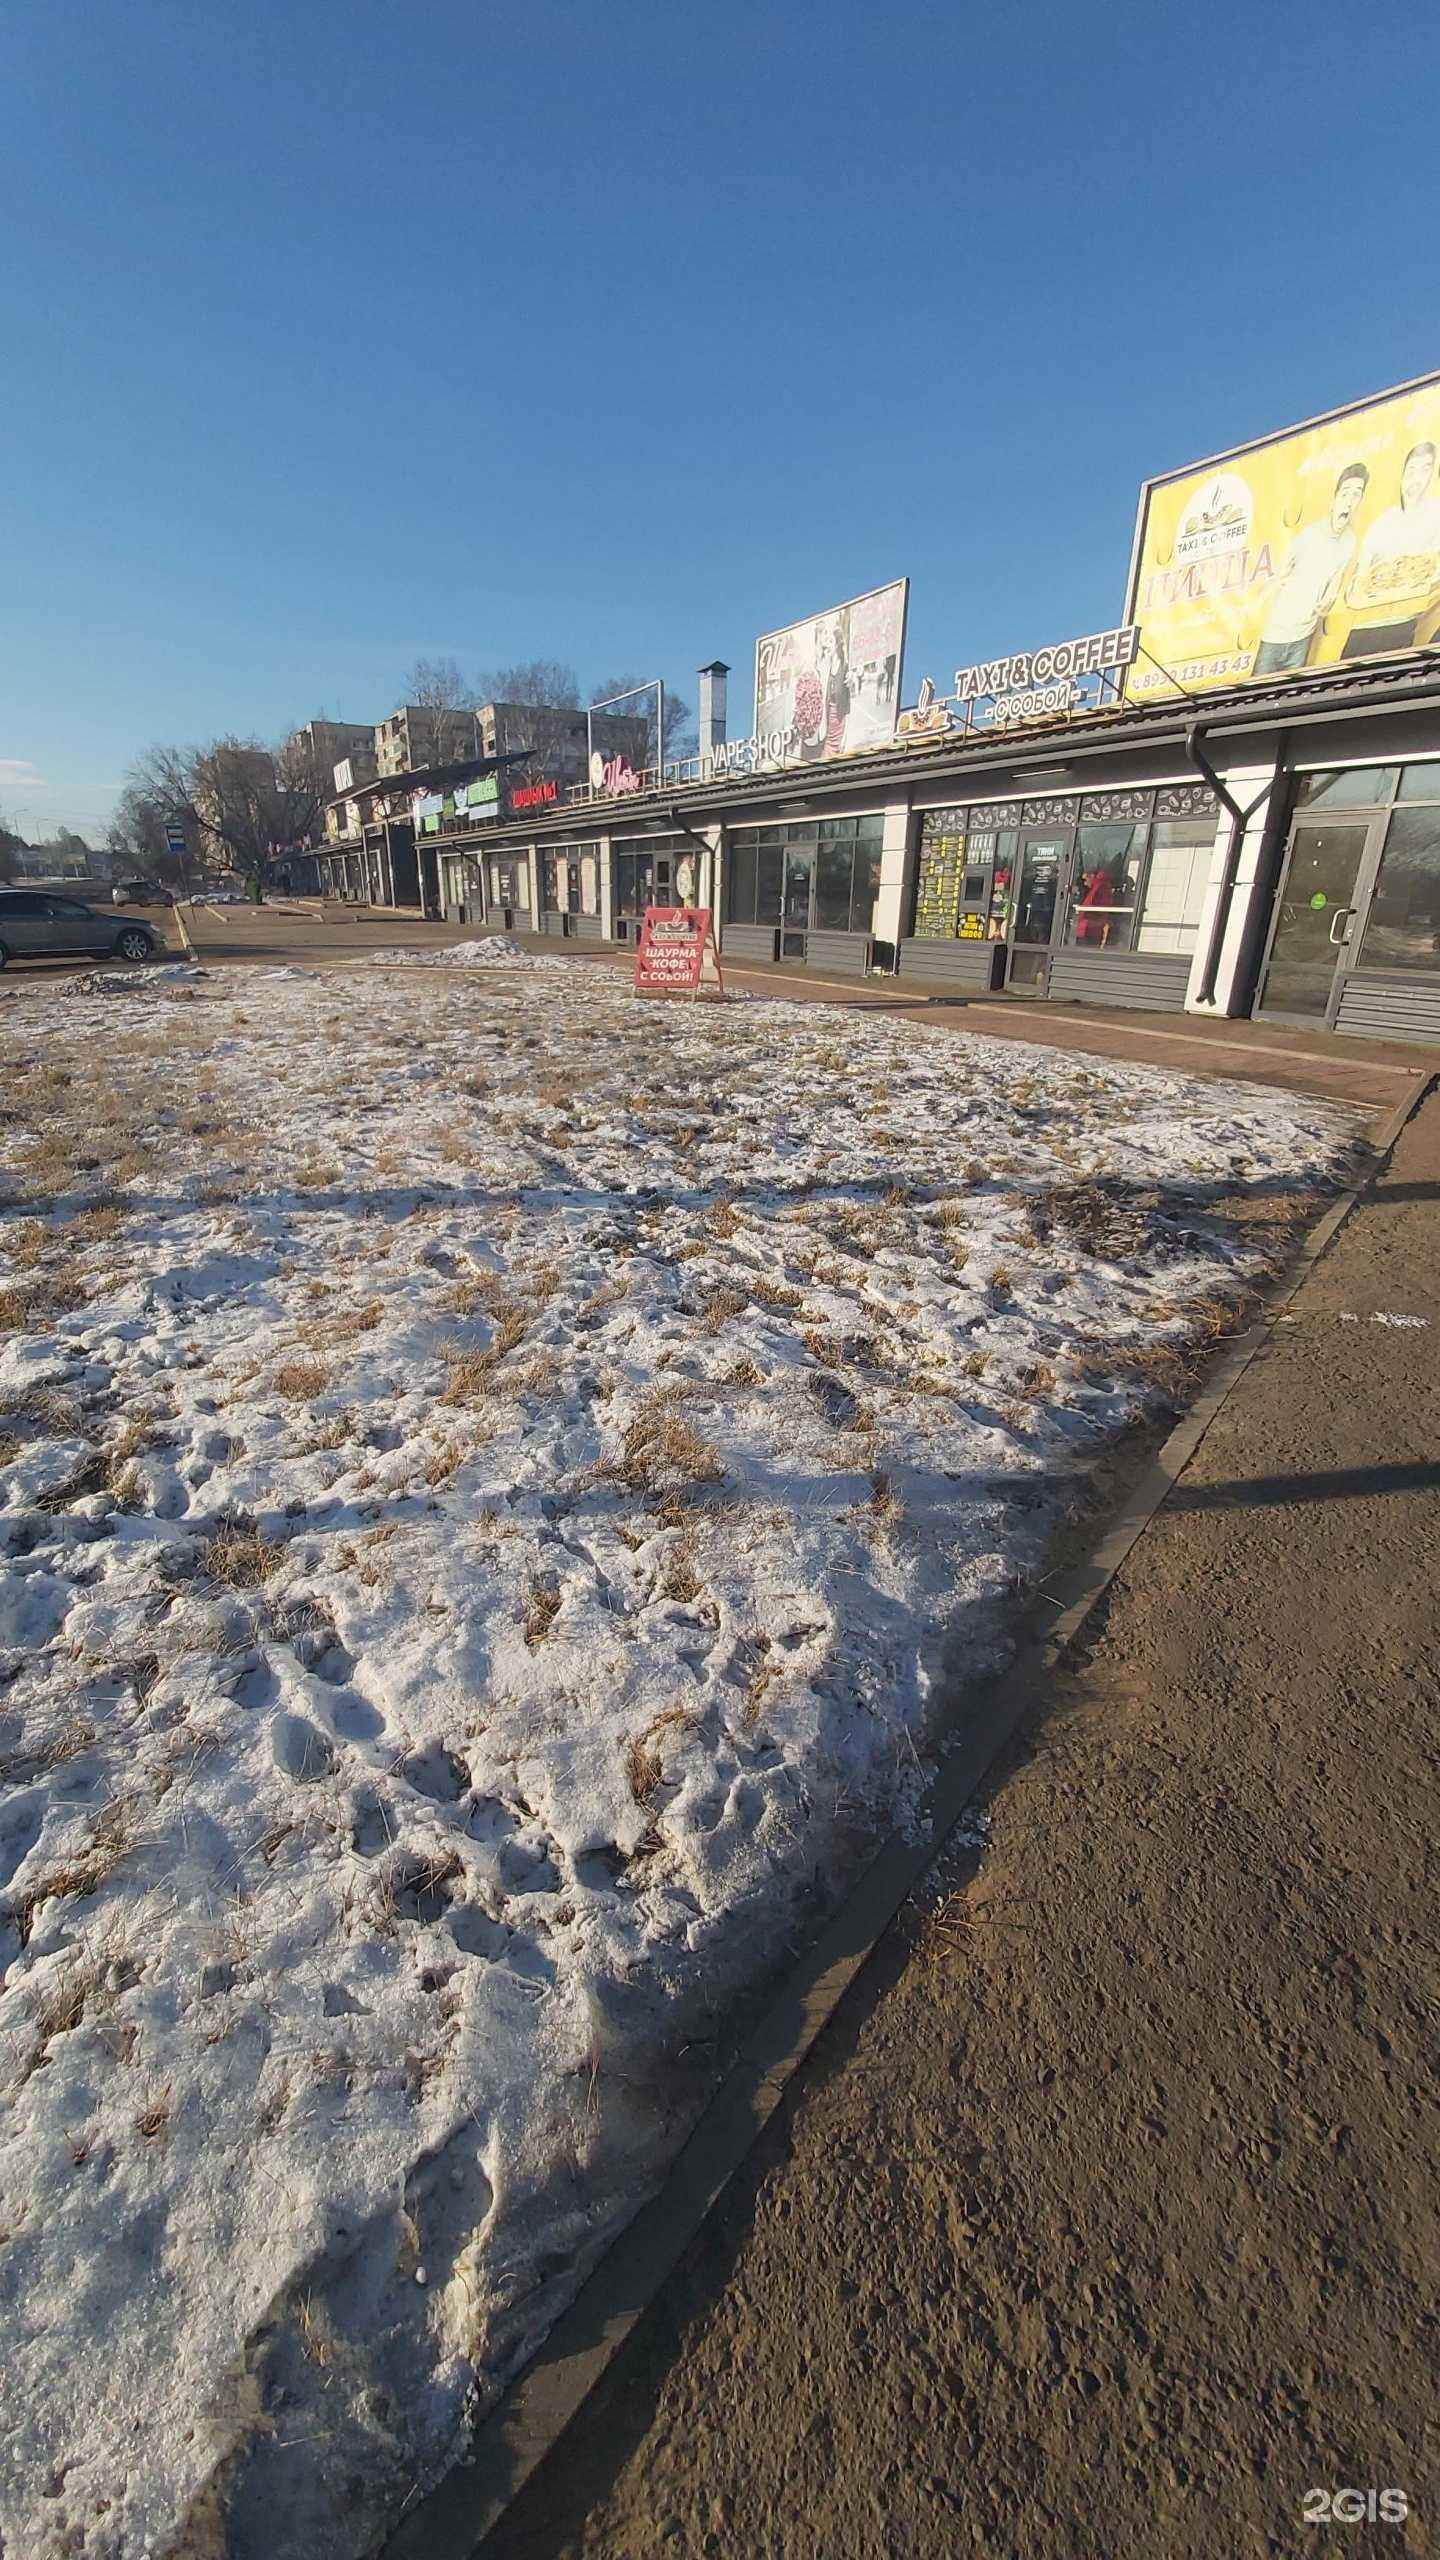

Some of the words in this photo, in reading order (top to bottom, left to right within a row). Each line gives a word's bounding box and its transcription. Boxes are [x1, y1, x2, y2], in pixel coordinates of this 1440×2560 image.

[1210, 524, 1248, 542] CFFEE
[956, 658, 1009, 700] TAXI
[1011, 656, 1028, 687] &
[1032, 629, 1135, 682] COFFEE
[1180, 664, 1205, 681] 131
[1209, 659, 1229, 676] 43
[1231, 655, 1252, 671] 43
[1009, 681, 1070, 719] СОБОЙ
[711, 739, 746, 768] VAPE
[748, 729, 792, 763] SHOP
[645, 948, 697, 958] ШАУРМА
[640, 971, 648, 980] С
